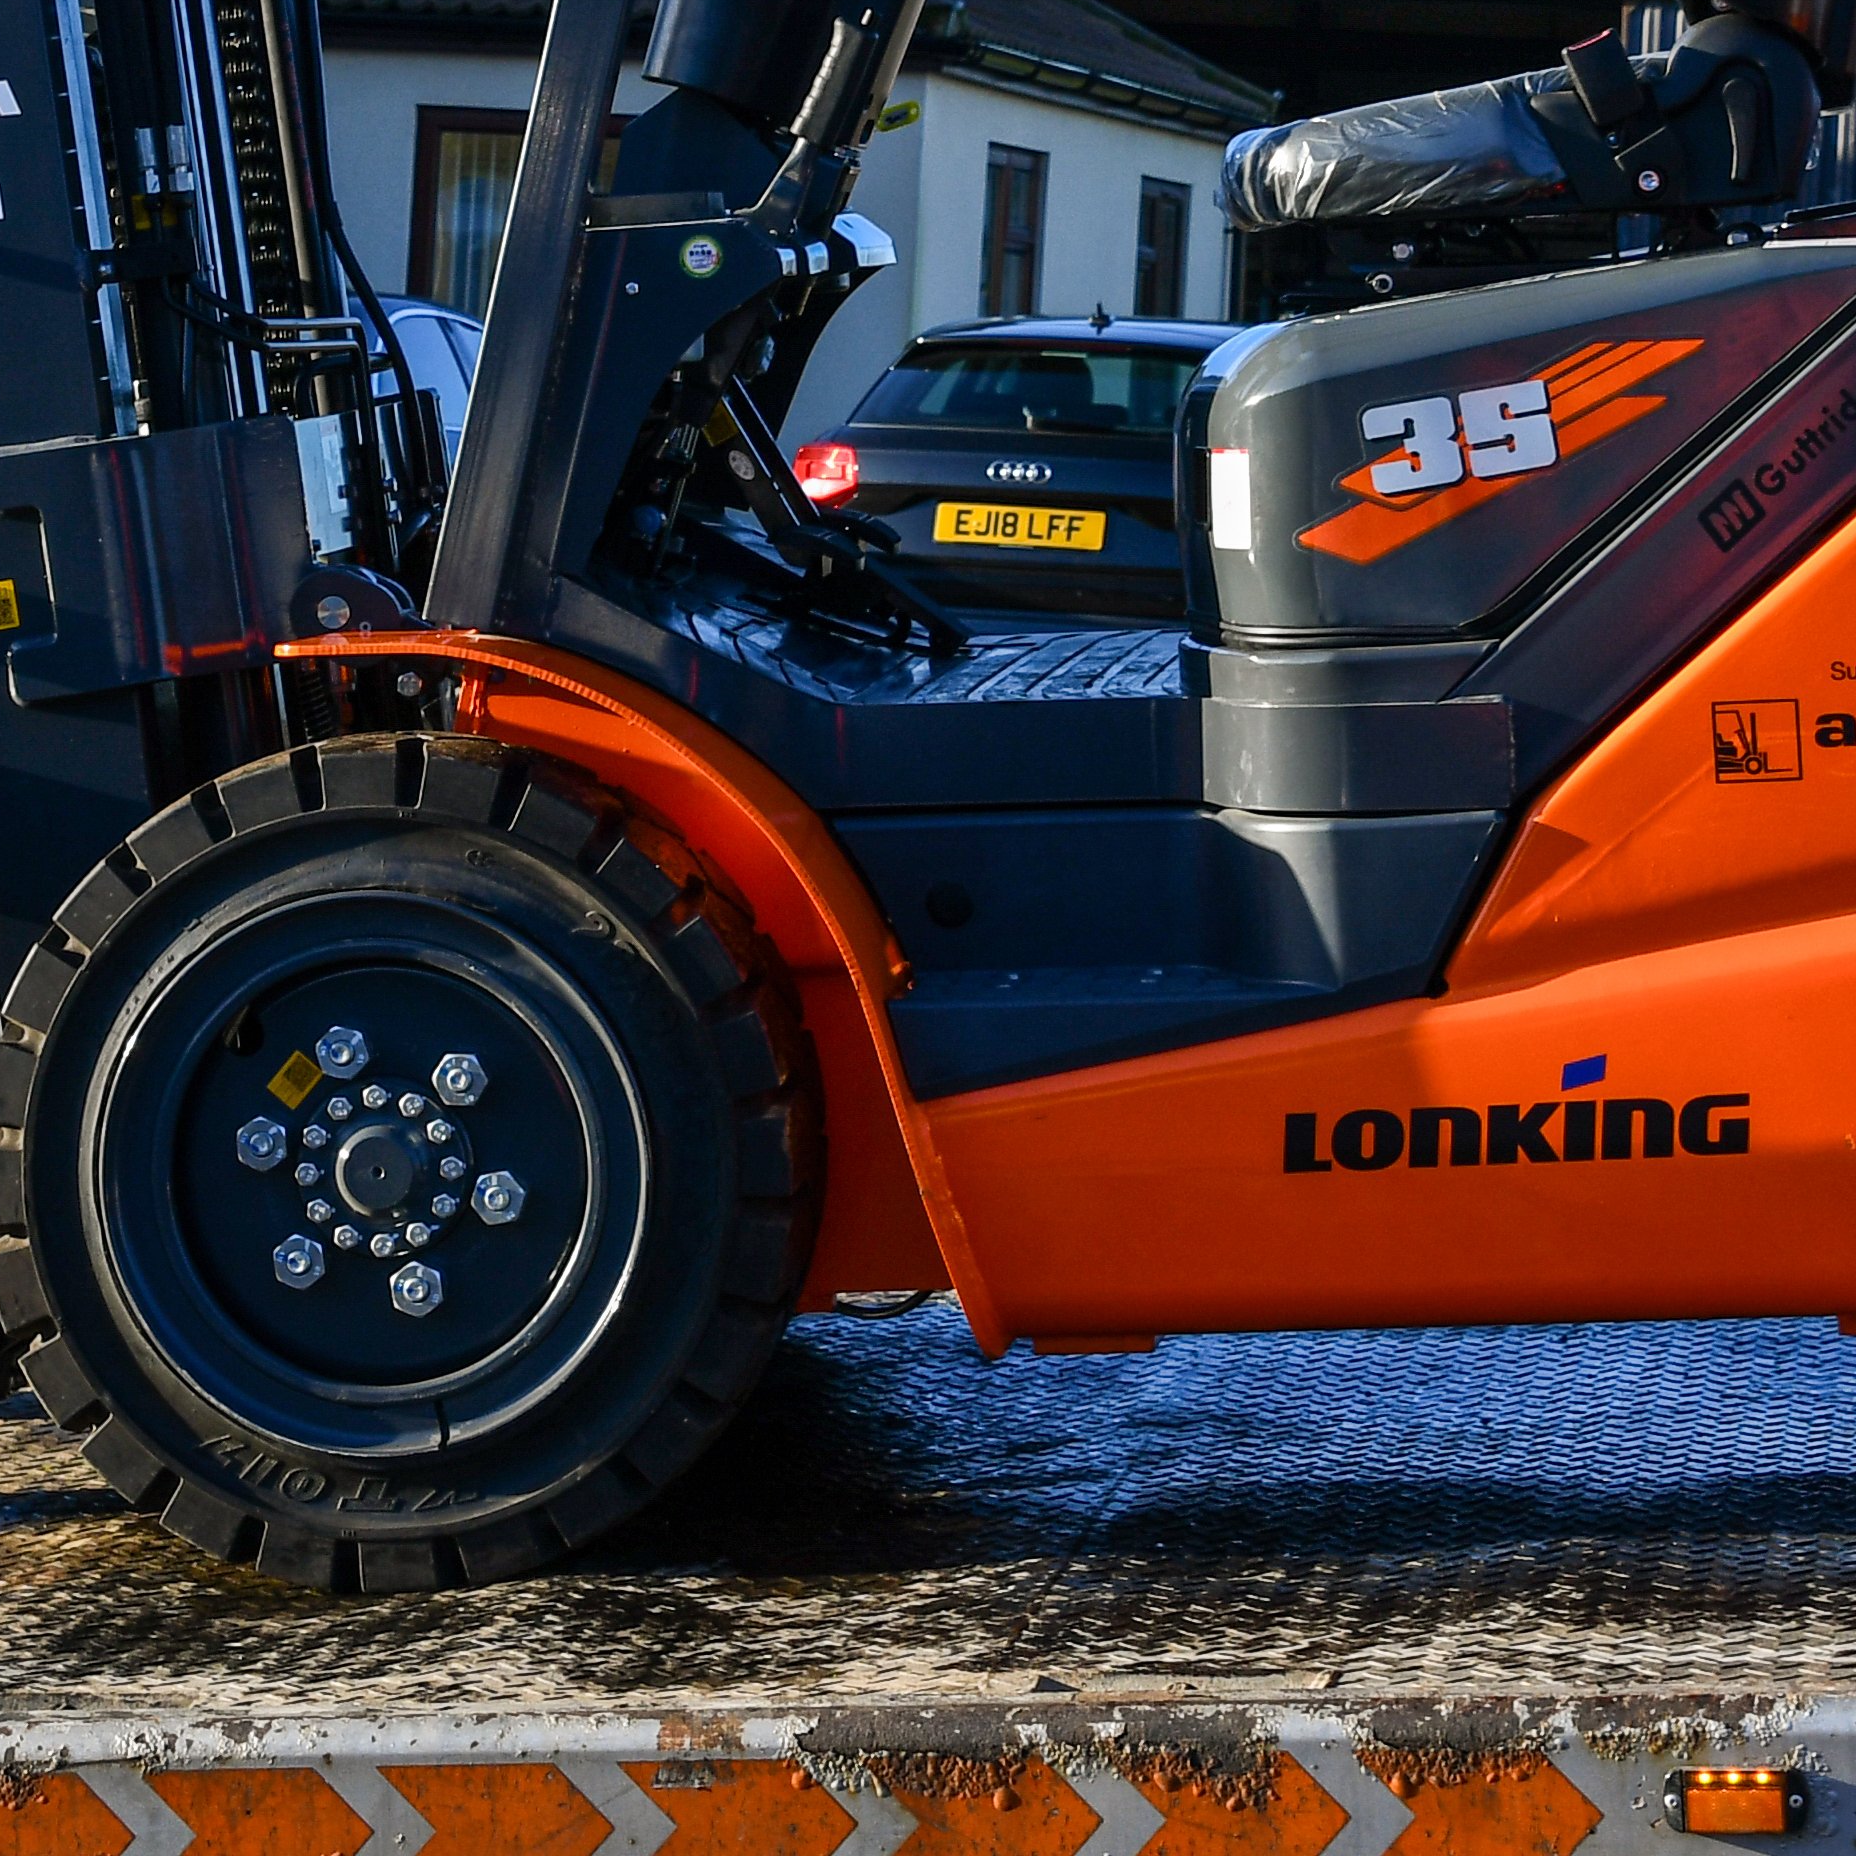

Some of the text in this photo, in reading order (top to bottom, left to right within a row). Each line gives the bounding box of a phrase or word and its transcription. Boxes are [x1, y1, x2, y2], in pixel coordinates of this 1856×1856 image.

[1362, 379, 1557, 495] 35
[954, 509, 1085, 542] EJ18 LFF
